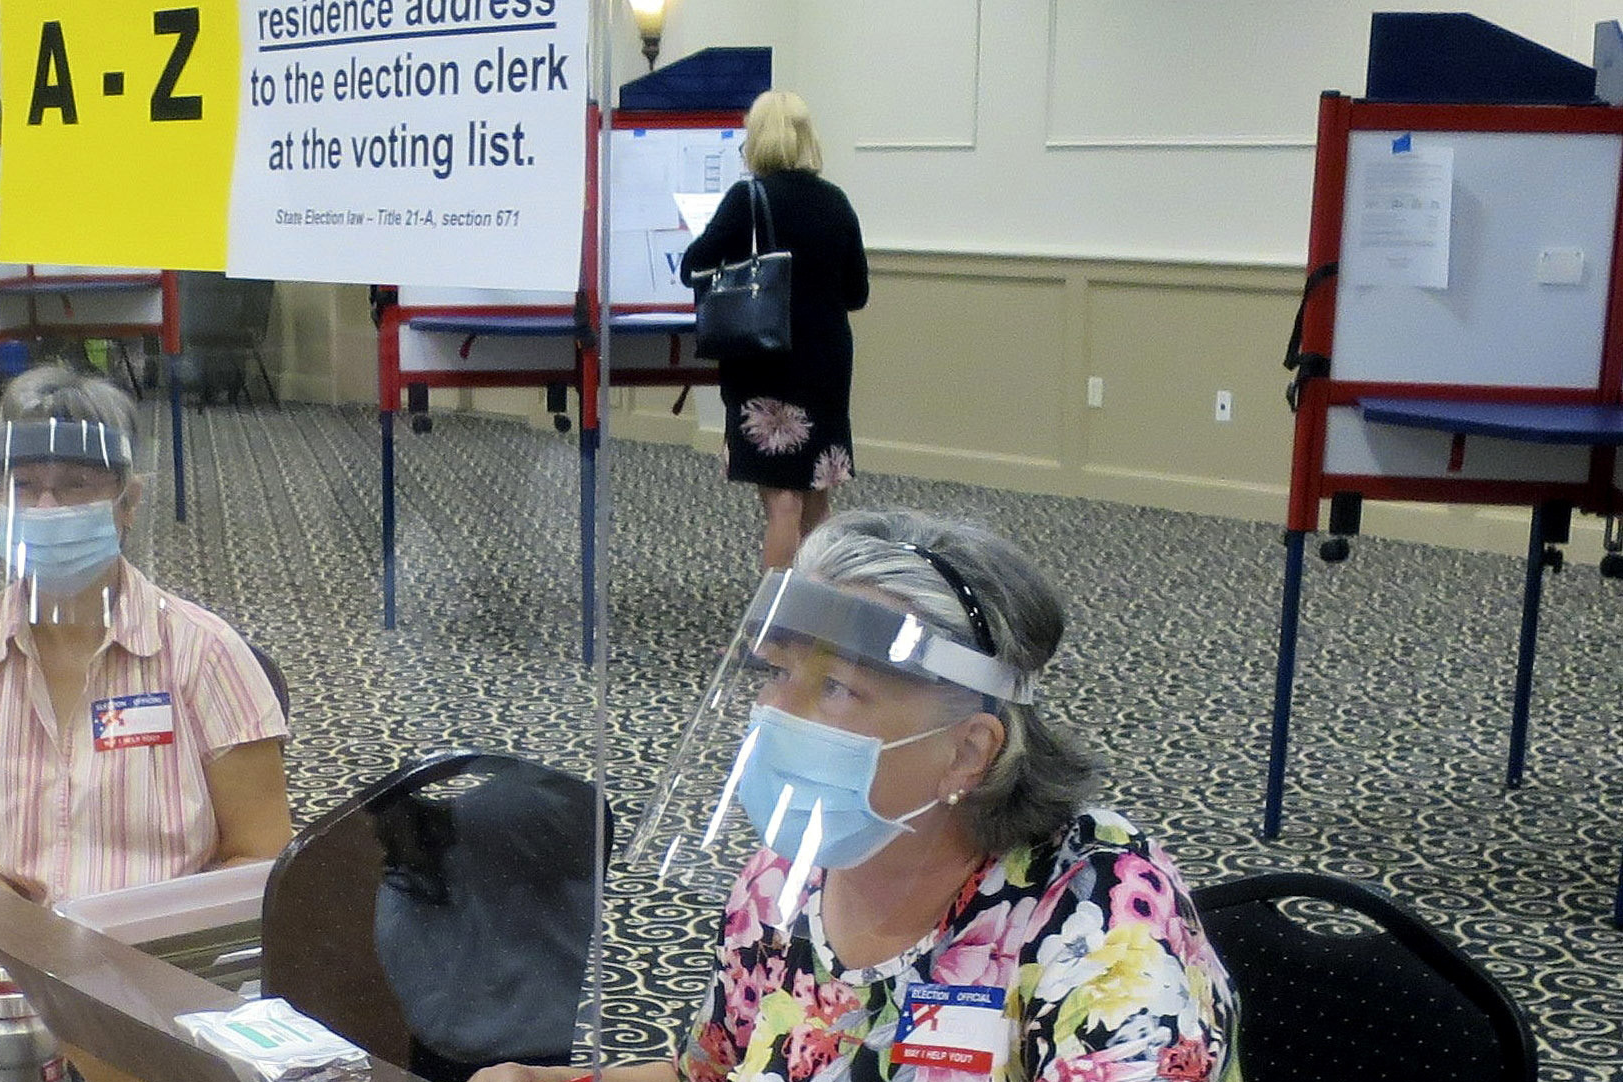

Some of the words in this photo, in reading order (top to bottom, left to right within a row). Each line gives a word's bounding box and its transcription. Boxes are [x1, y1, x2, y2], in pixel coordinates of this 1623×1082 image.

[258, 0, 394, 40] residence
[28, 20, 79, 126] A
[149, 7, 204, 122] Z
[250, 66, 276, 107] to
[284, 61, 325, 105] the
[333, 52, 460, 102] election
[474, 43, 570, 95] clerk
[268, 130, 294, 171] at
[301, 127, 342, 170] the
[351, 122, 454, 180] voting
[467, 120, 536, 167] list.
[275, 208, 303, 227] State
[305, 207, 345, 227] Election
[347, 208, 364, 226] law
[377, 208, 402, 227] Title
[441, 208, 492, 227] section
[495, 209, 520, 227] 671
[911, 988, 950, 1001] ELECTION
